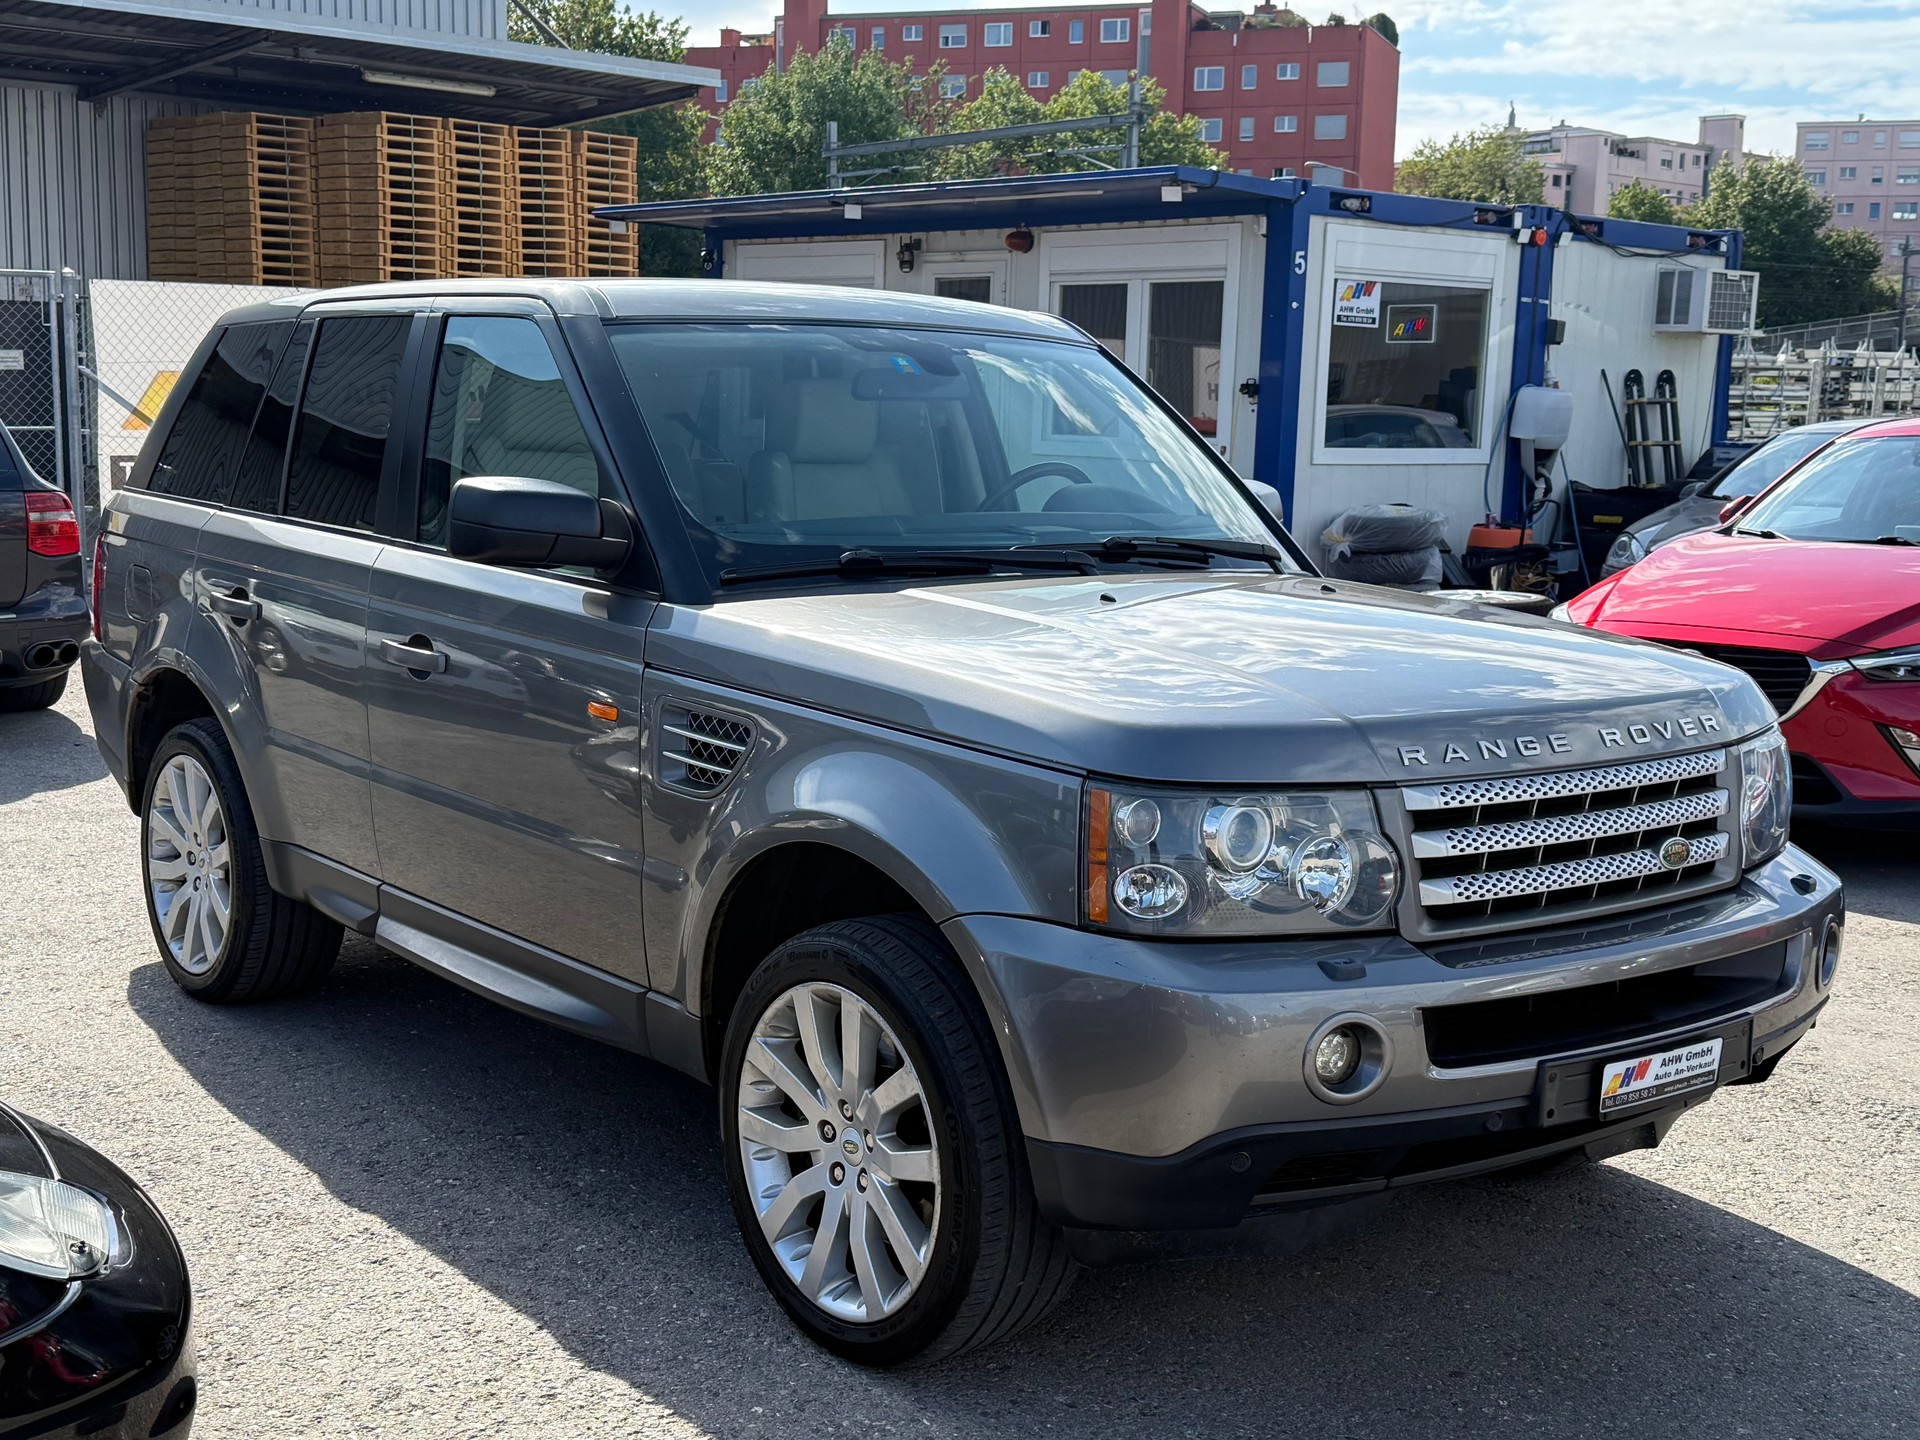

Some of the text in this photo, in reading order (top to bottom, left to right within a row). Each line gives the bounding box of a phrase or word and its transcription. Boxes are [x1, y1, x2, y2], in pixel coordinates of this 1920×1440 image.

[1294, 250, 1306, 275] 5
[1339, 281, 1377, 302] AHW
[1339, 305, 1354, 314] AHW
[1393, 318, 1426, 336] AHW
[1398, 714, 1721, 766] RANGE ROVER
[1660, 1046, 1713, 1068] AHW GmbH
[1603, 1059, 1653, 1096] AHW
[1654, 1058, 1715, 1081] Auto An-Verkauf
[1604, 1087, 1657, 1108] Tel. 079 858 58 24
